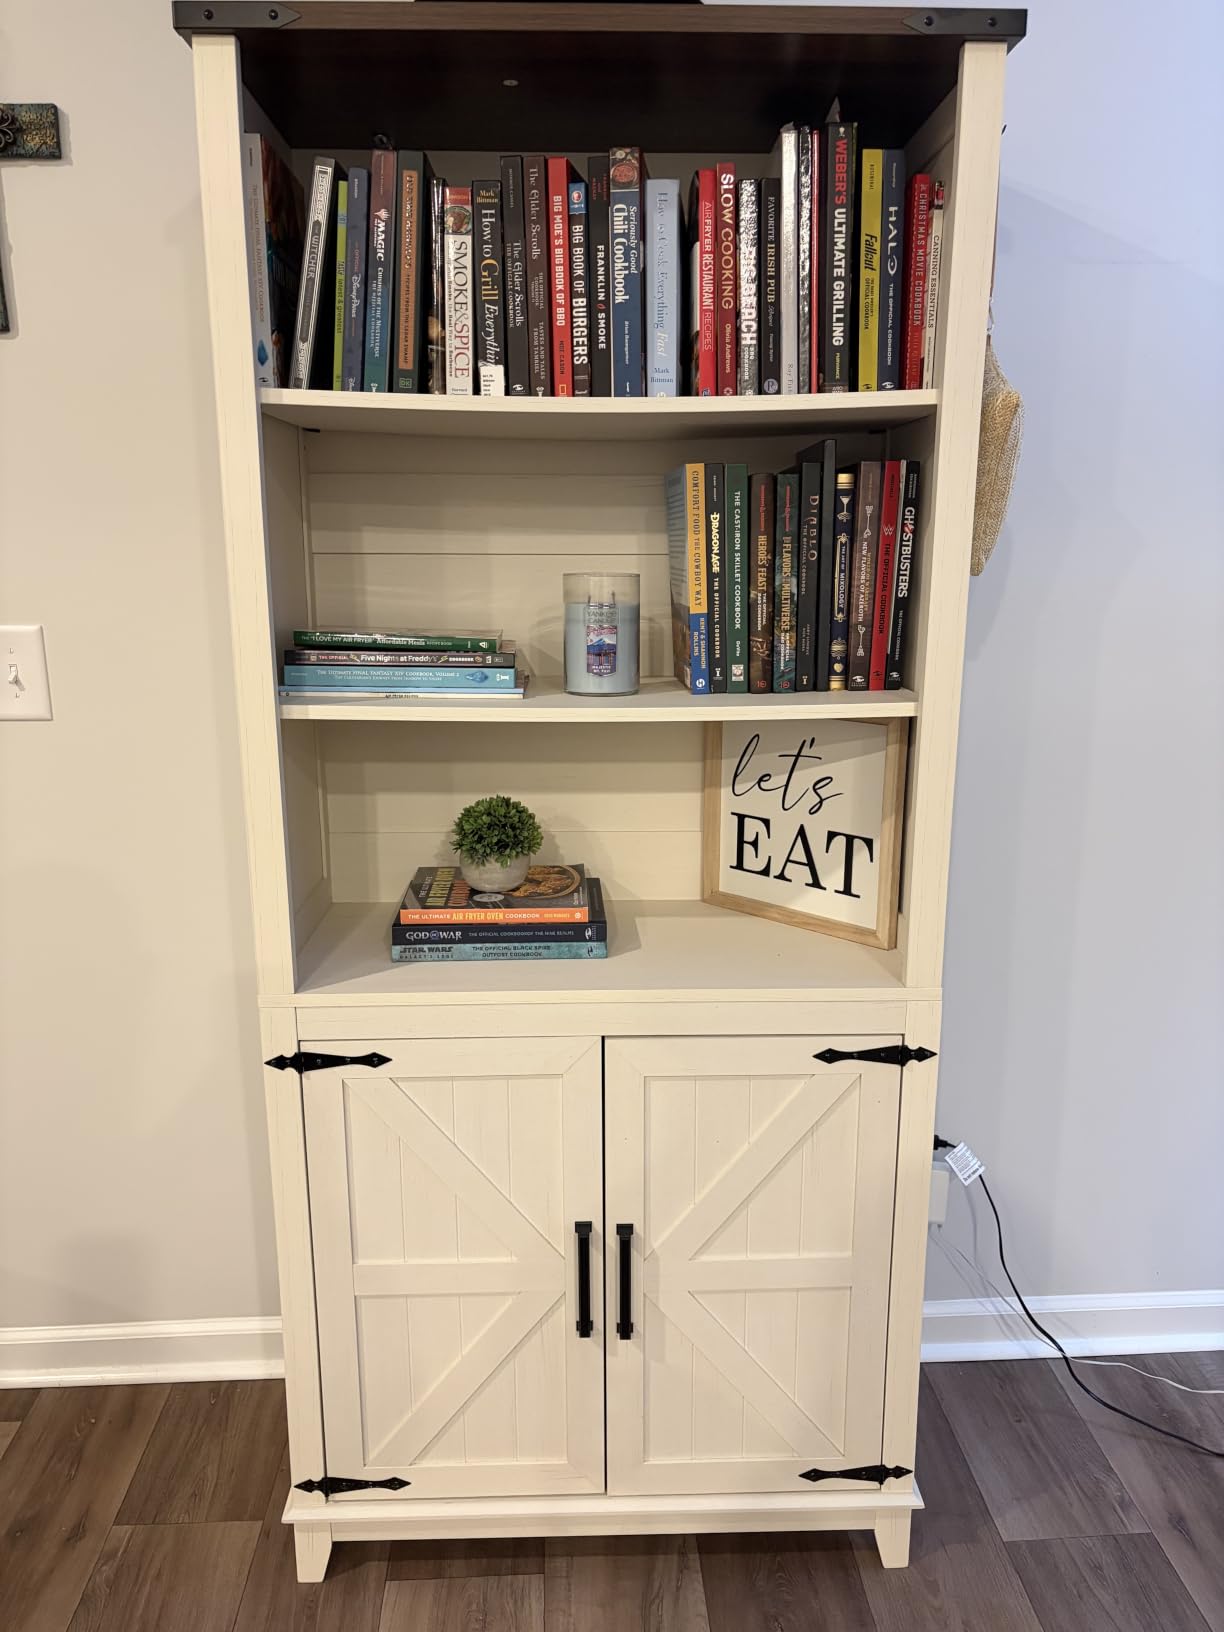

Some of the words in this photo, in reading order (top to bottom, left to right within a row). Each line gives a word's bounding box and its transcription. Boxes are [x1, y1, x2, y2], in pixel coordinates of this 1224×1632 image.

[530, 168, 539, 186] The
[834, 138, 848, 205] WEBER'S
[529, 190, 540, 221] Elder
[554, 196, 563, 212] BIG
[721, 173, 734, 225] SLOW
[482, 210, 496, 242] How
[554, 215, 563, 246] MOE'S
[572, 225, 584, 244] BIG
[613, 204, 629, 234] Chili
[629, 206, 638, 248] Seriously
[768, 197, 776, 241] FAVORITE
[917, 193, 928, 246] CHRISTMAS
[307, 235, 321, 279] WITCHER
[377, 220, 386, 261] MAGIC
[483, 244, 493, 258] to
[514, 240, 522, 259] The
[531, 224, 541, 260] Scrolls
[555, 248, 564, 265] BIG
[833, 208, 846, 277] ULTIMATE
[864, 233, 878, 272] Fallout
[888, 207, 899, 276] HALO
[930, 235, 940, 275] CANNING
[513, 262, 523, 291] Elder
[573, 247, 585, 277] BOOK
[597, 245, 605, 301] FRANKLIN
[614, 238, 630, 305] Cookbook
[630, 250, 638, 274] Good
[722, 228, 734, 310] COOKING
[768, 243, 776, 276] IRISH
[915, 250, 924, 276] MOVIE
[481, 259, 500, 300] Grill
[556, 266, 565, 291] BOOK
[574, 281, 585, 294] OF
[702, 254, 714, 310] RESTAURANT
[767, 279, 776, 303] PUB
[515, 294, 525, 327] Scrolls
[556, 293, 565, 305] OF
[556, 307, 566, 327] BBQ
[654, 271, 669, 330] Everything
[832, 281, 845, 347] GRILLING
[913, 281, 923, 326] COOKBOOK
[928, 278, 937, 328] ESSENTIALS
[374, 319, 382, 358] MULTIVERSE
[572, 298, 588, 365] BURGERS
[598, 313, 606, 350] SMOKE
[657, 332, 669, 358] Fast
[704, 313, 712, 351] RECIPES
[692, 471, 700, 511] COMFORT
[693, 514, 701, 536] FOOD
[806, 495, 819, 561] DIABLO
[694, 553, 702, 587] COWBOY
[782, 544, 792, 577] FLAVORS
[882, 559, 890, 592] OFFICIAL
[757, 568, 767, 591] FEAST
[860, 585, 865, 593] OF
[781, 584, 791, 631] MULTIVERSE
[879, 595, 887, 635] COOKBOOK
[377, 655, 399, 663] Nights
[408, 655, 439, 663] Freddy's
[732, 734, 844, 815] let's
[730, 812, 874, 899] EAT
[406, 932, 429, 941] GOD
[440, 931, 462, 941] WAR
